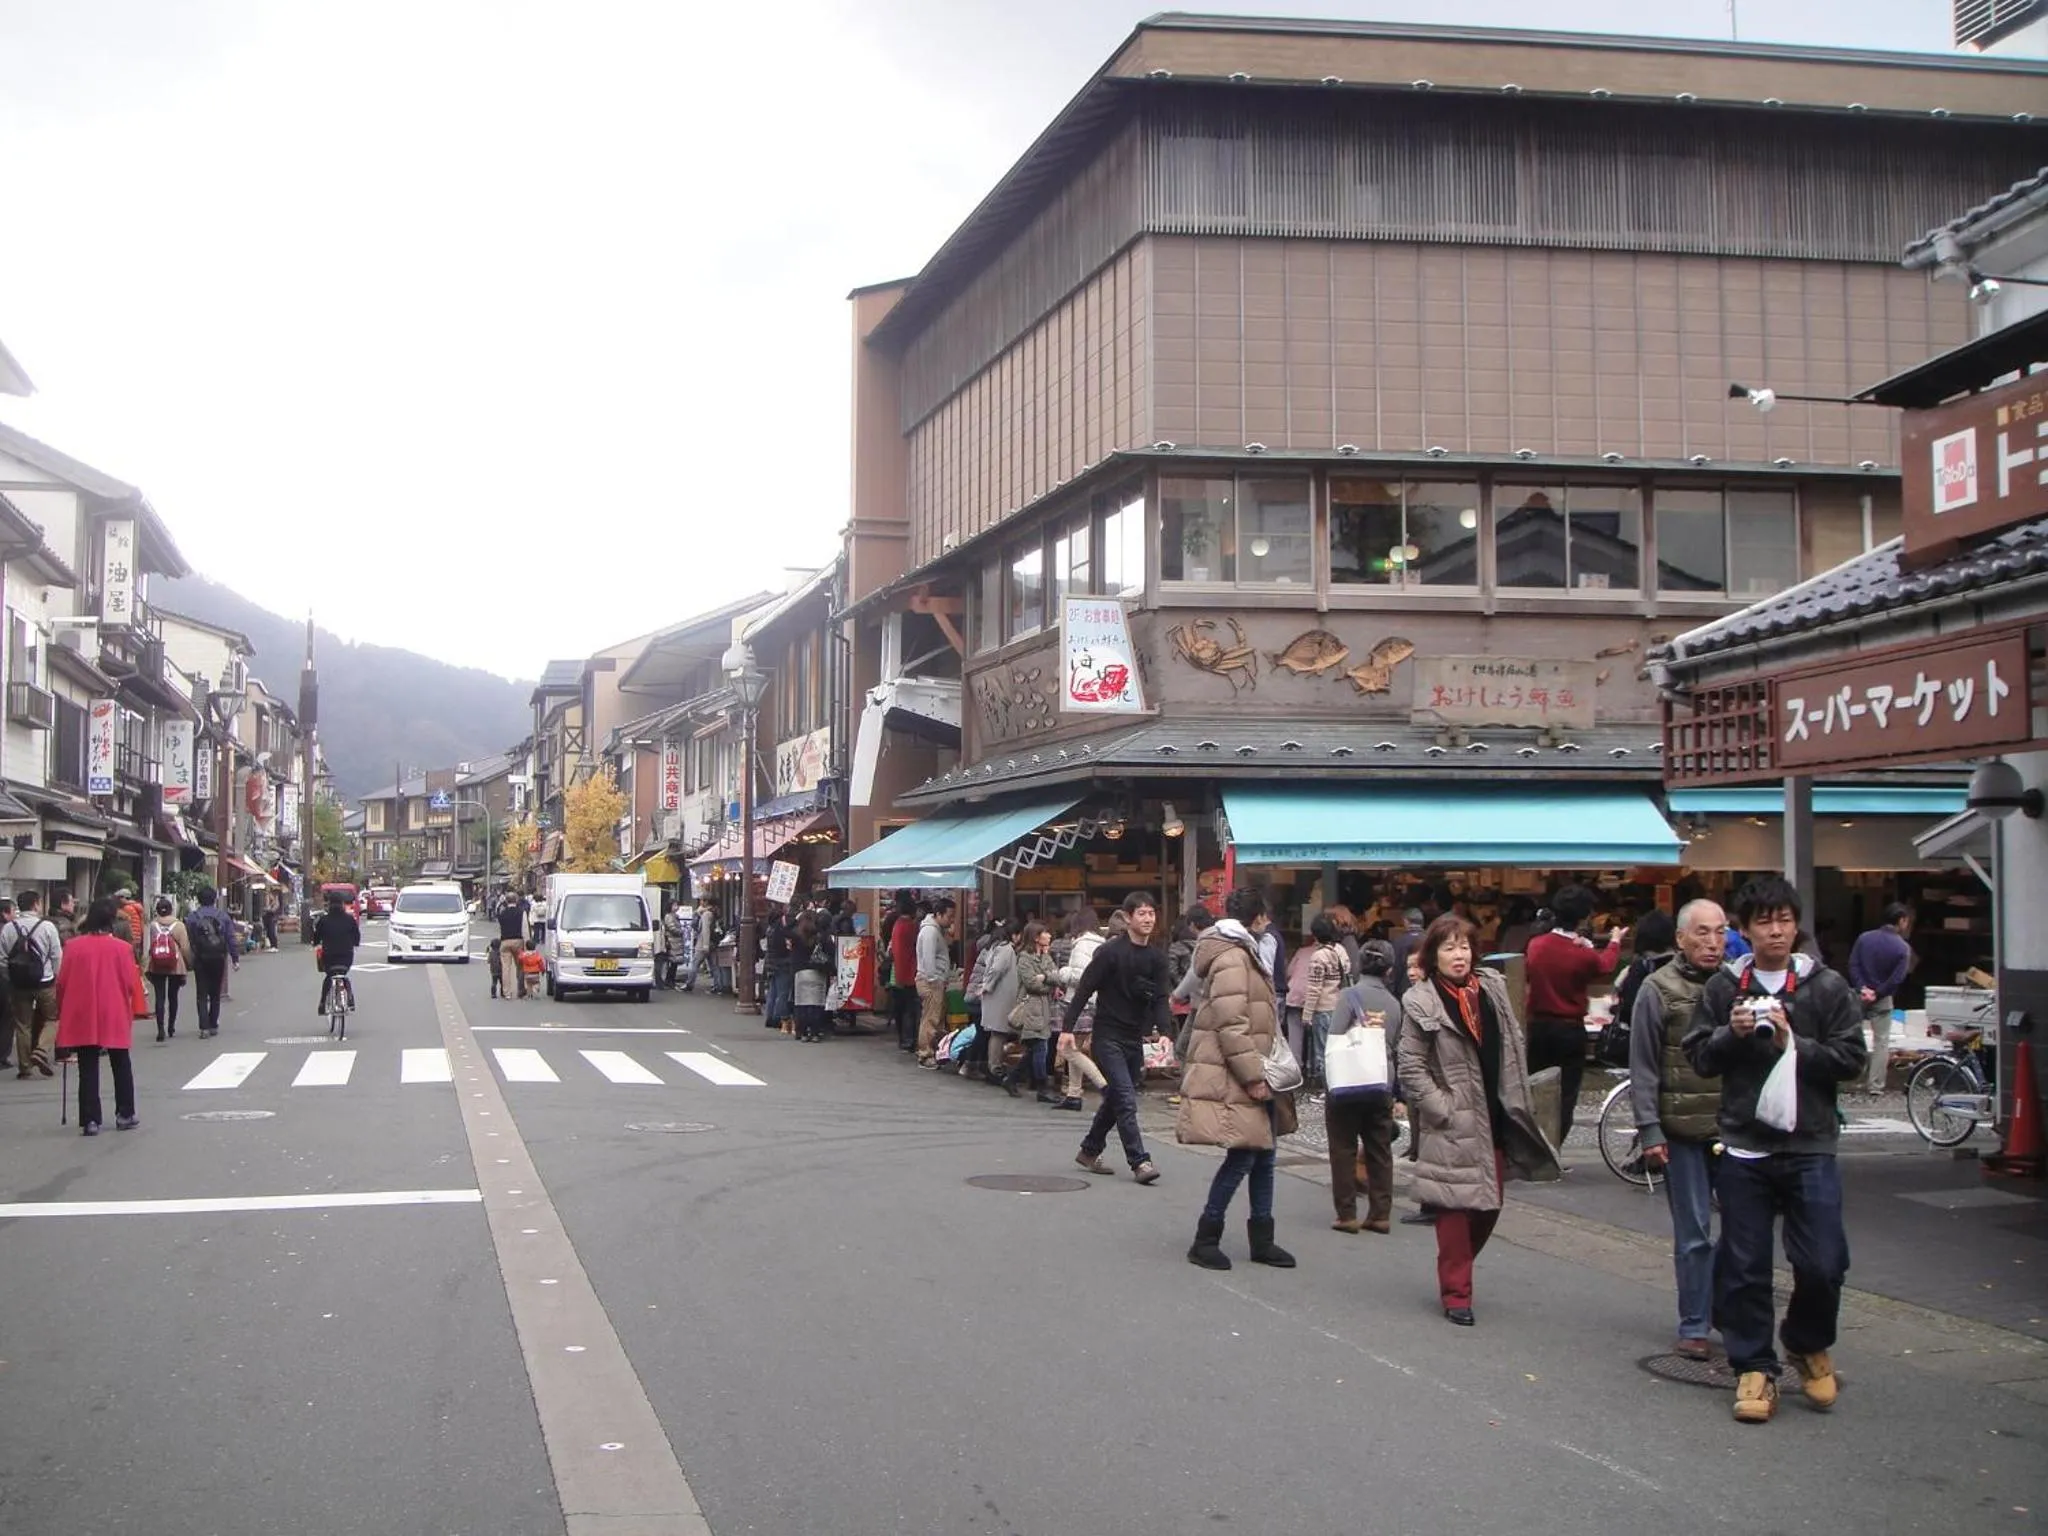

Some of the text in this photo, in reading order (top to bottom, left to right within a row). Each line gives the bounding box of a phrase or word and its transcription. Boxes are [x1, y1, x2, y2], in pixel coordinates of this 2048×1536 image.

[1784, 659, 2009, 743] スーパーマーケット
